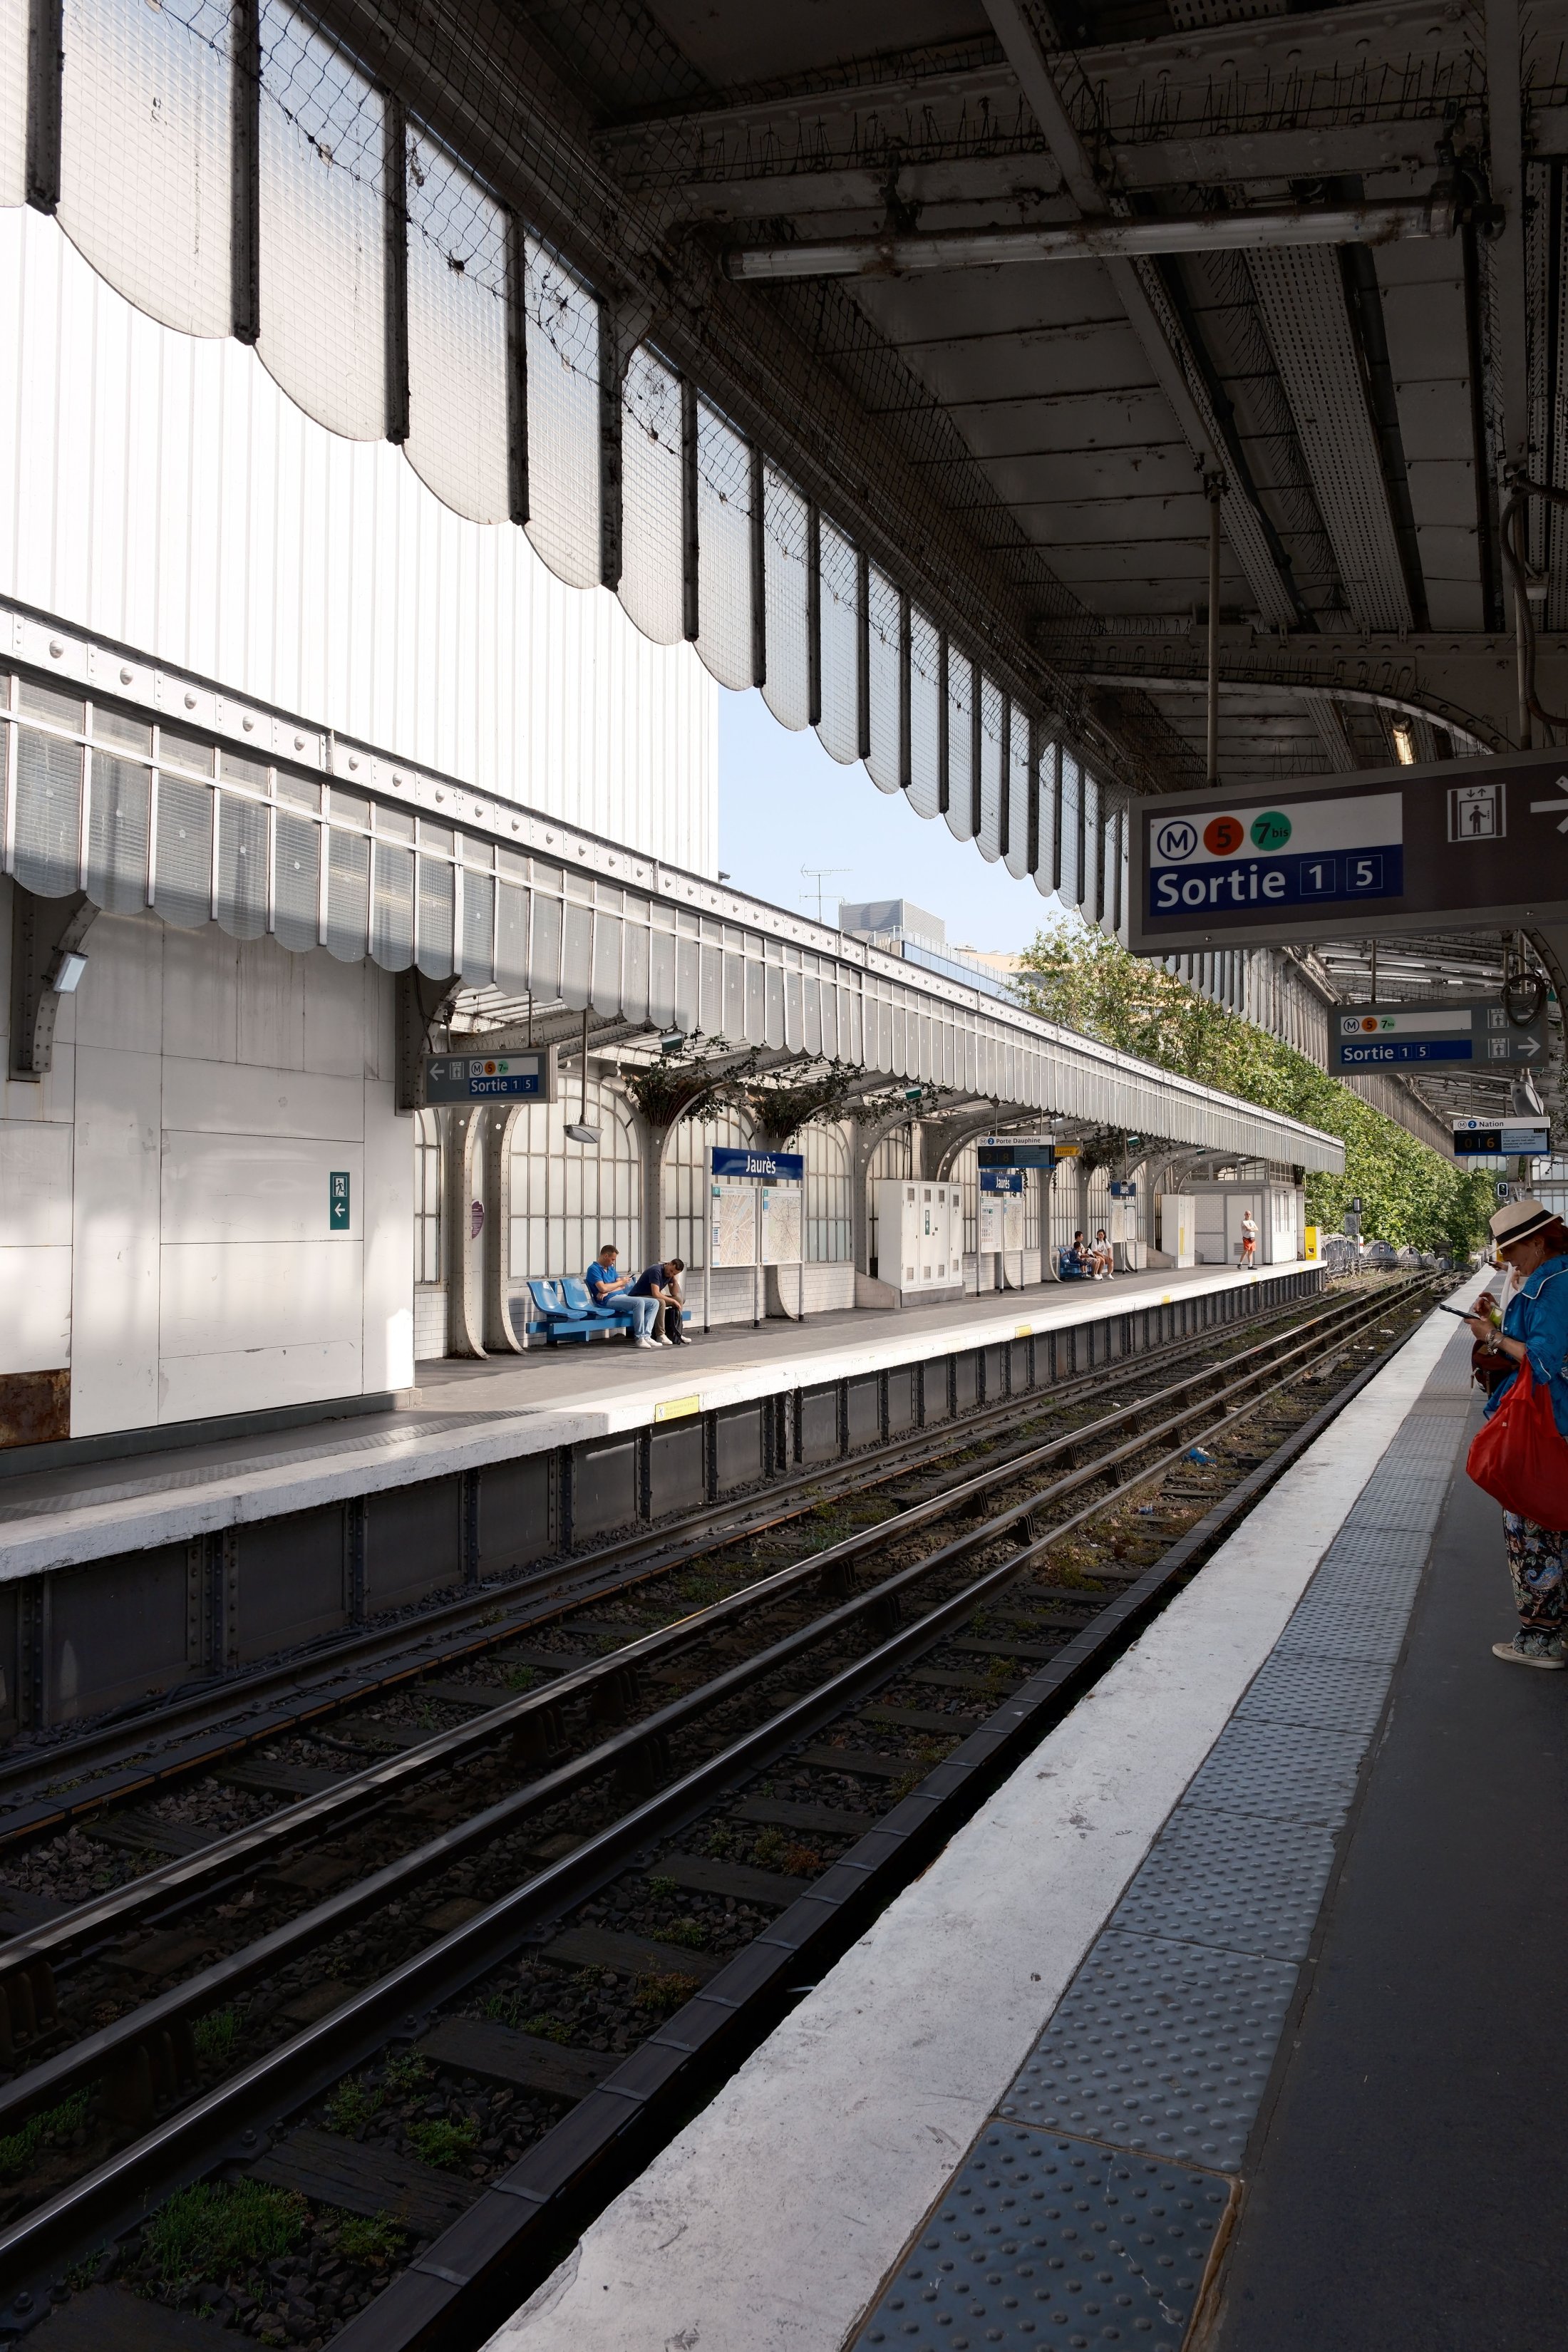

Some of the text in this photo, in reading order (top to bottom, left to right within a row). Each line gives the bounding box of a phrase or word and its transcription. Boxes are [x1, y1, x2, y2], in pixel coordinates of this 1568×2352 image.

[1166, 829, 1188, 852] M
[1216, 825, 1232, 848] 5
[1156, 860, 1373, 907] Sortie 1 5
[1366, 1021, 1373, 1029] 5
[1343, 1046, 1426, 1061] Sortie 1 5
[471, 1078, 531, 1092] Sortie 1 5
[1487, 1138, 1495, 1148] 6
[986, 1153, 992, 1162] 2
[1003, 1152, 1009, 1162] 8
[746, 1155, 776, 1175] Jaurès
[996, 1176, 1010, 1189] Jaurès
